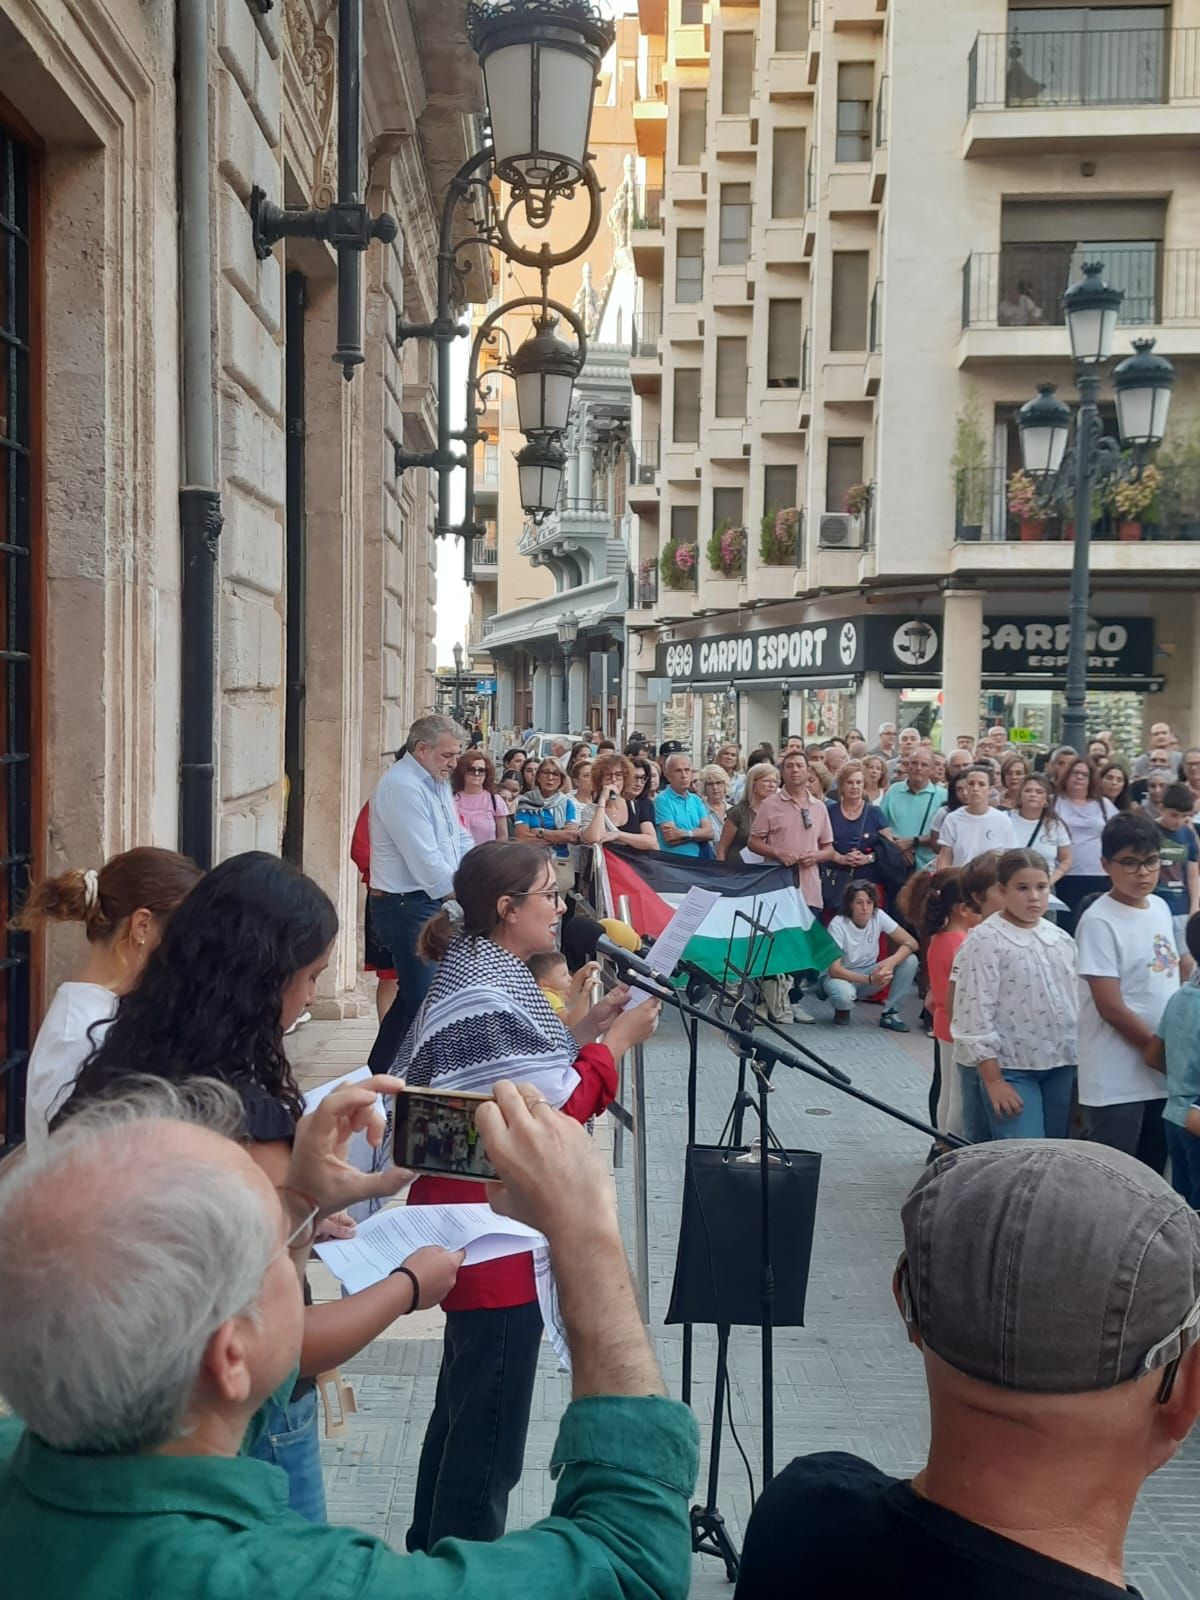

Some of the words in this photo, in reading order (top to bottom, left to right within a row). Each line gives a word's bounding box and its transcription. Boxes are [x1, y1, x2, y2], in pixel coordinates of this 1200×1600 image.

[700, 637, 753, 674] CARPIO
[757, 628, 827, 671] ESPORT
[1028, 655, 1120, 668] ESPRT
